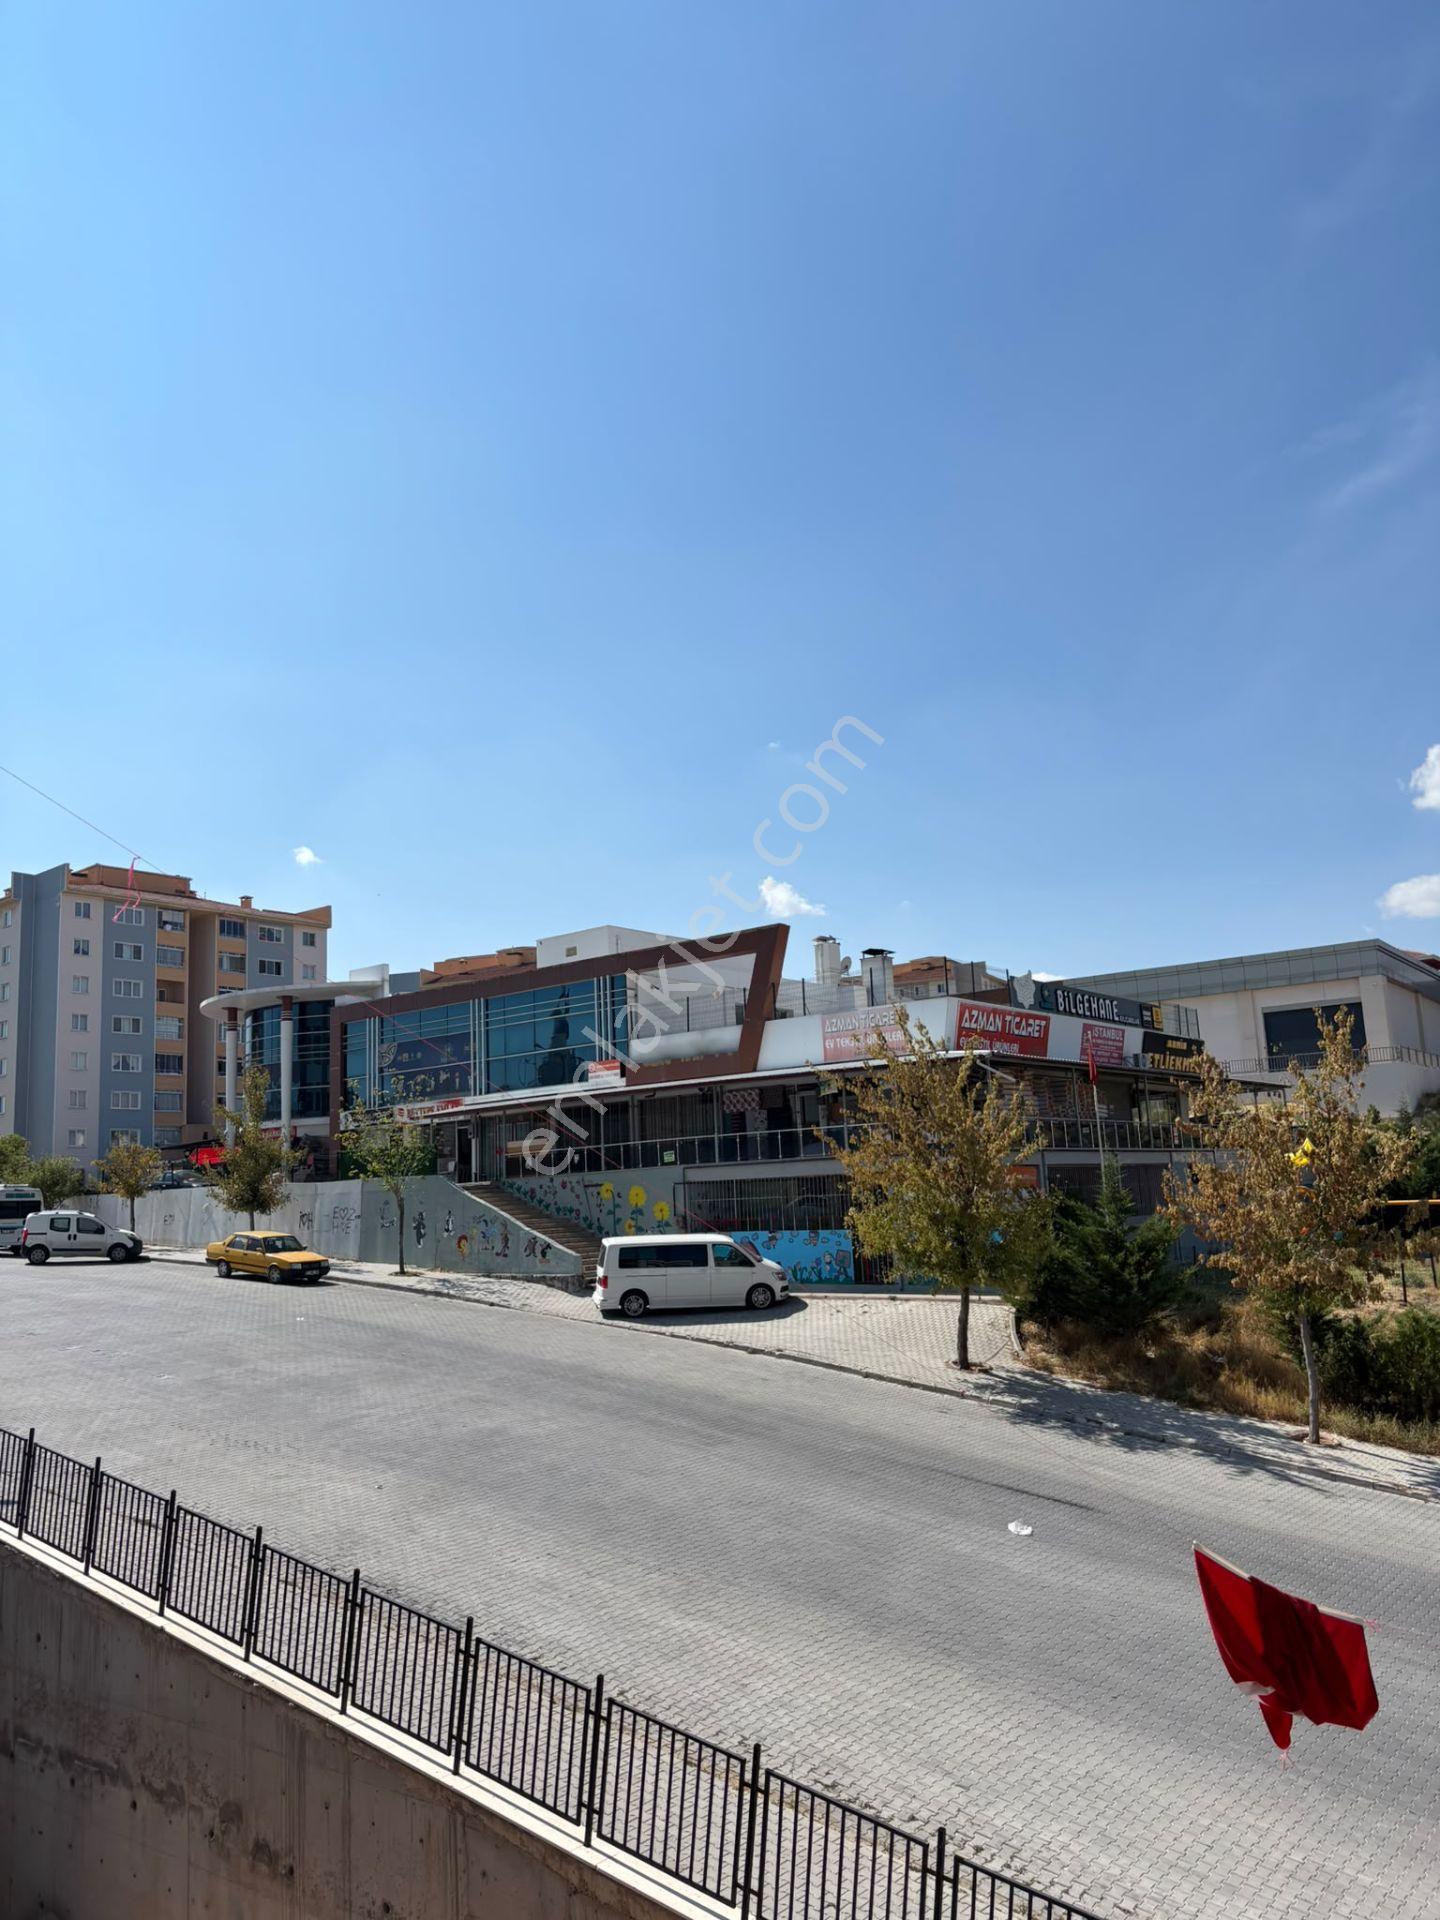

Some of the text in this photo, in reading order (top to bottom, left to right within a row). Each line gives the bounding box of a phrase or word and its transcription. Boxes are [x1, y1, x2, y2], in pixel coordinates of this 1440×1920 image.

[824, 1010, 897, 1033] AZMAN TİCARE
[961, 1008, 1046, 1038] AZMAN TİCARET
[1146, 1051, 1198, 1072] ETLİEKME
